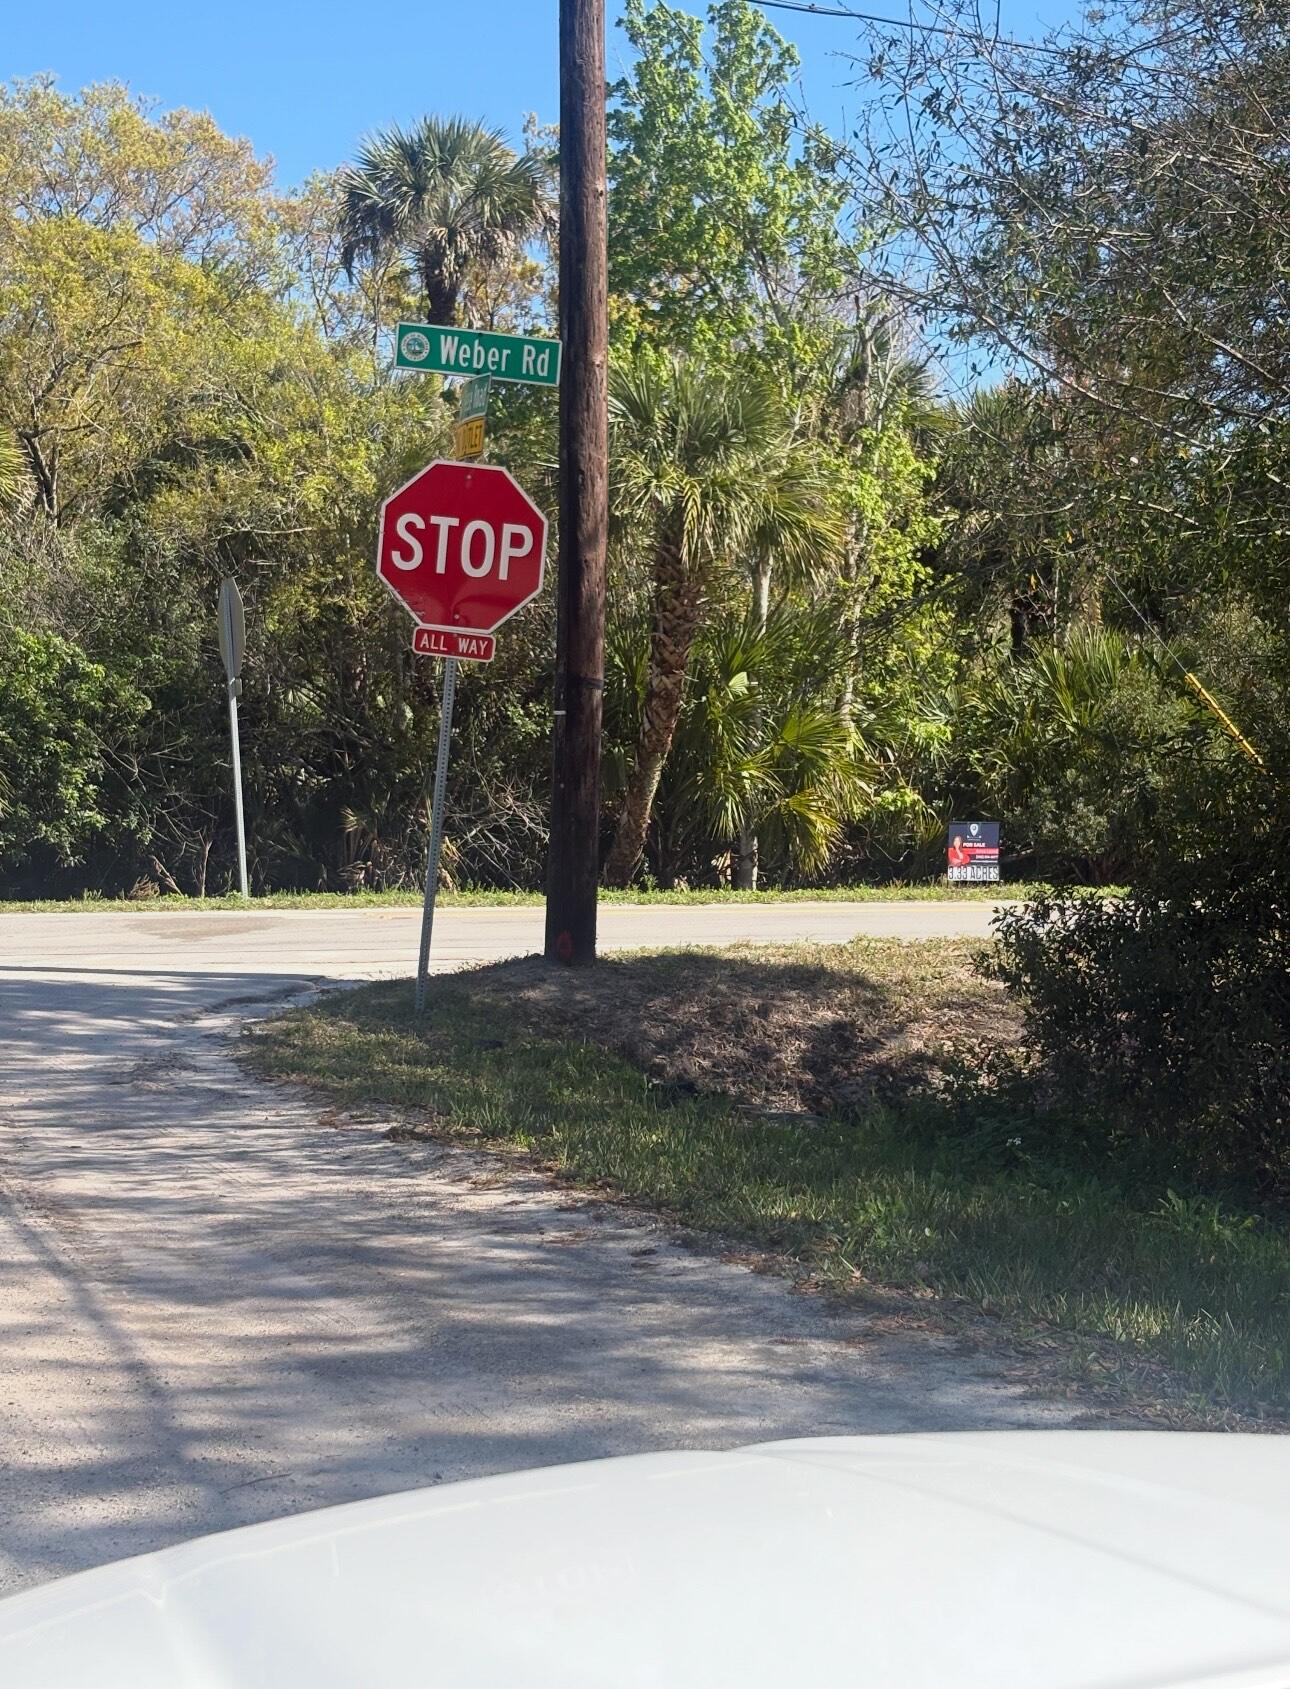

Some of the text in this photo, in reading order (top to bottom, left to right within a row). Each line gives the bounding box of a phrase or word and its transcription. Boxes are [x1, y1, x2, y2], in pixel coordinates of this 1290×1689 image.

[440, 334, 511, 372] Weber
[522, 344, 550, 377] Rd
[391, 513, 534, 581] STOP
[420, 633, 488, 656] ALL WAY
[970, 866, 998, 880] ACRES
